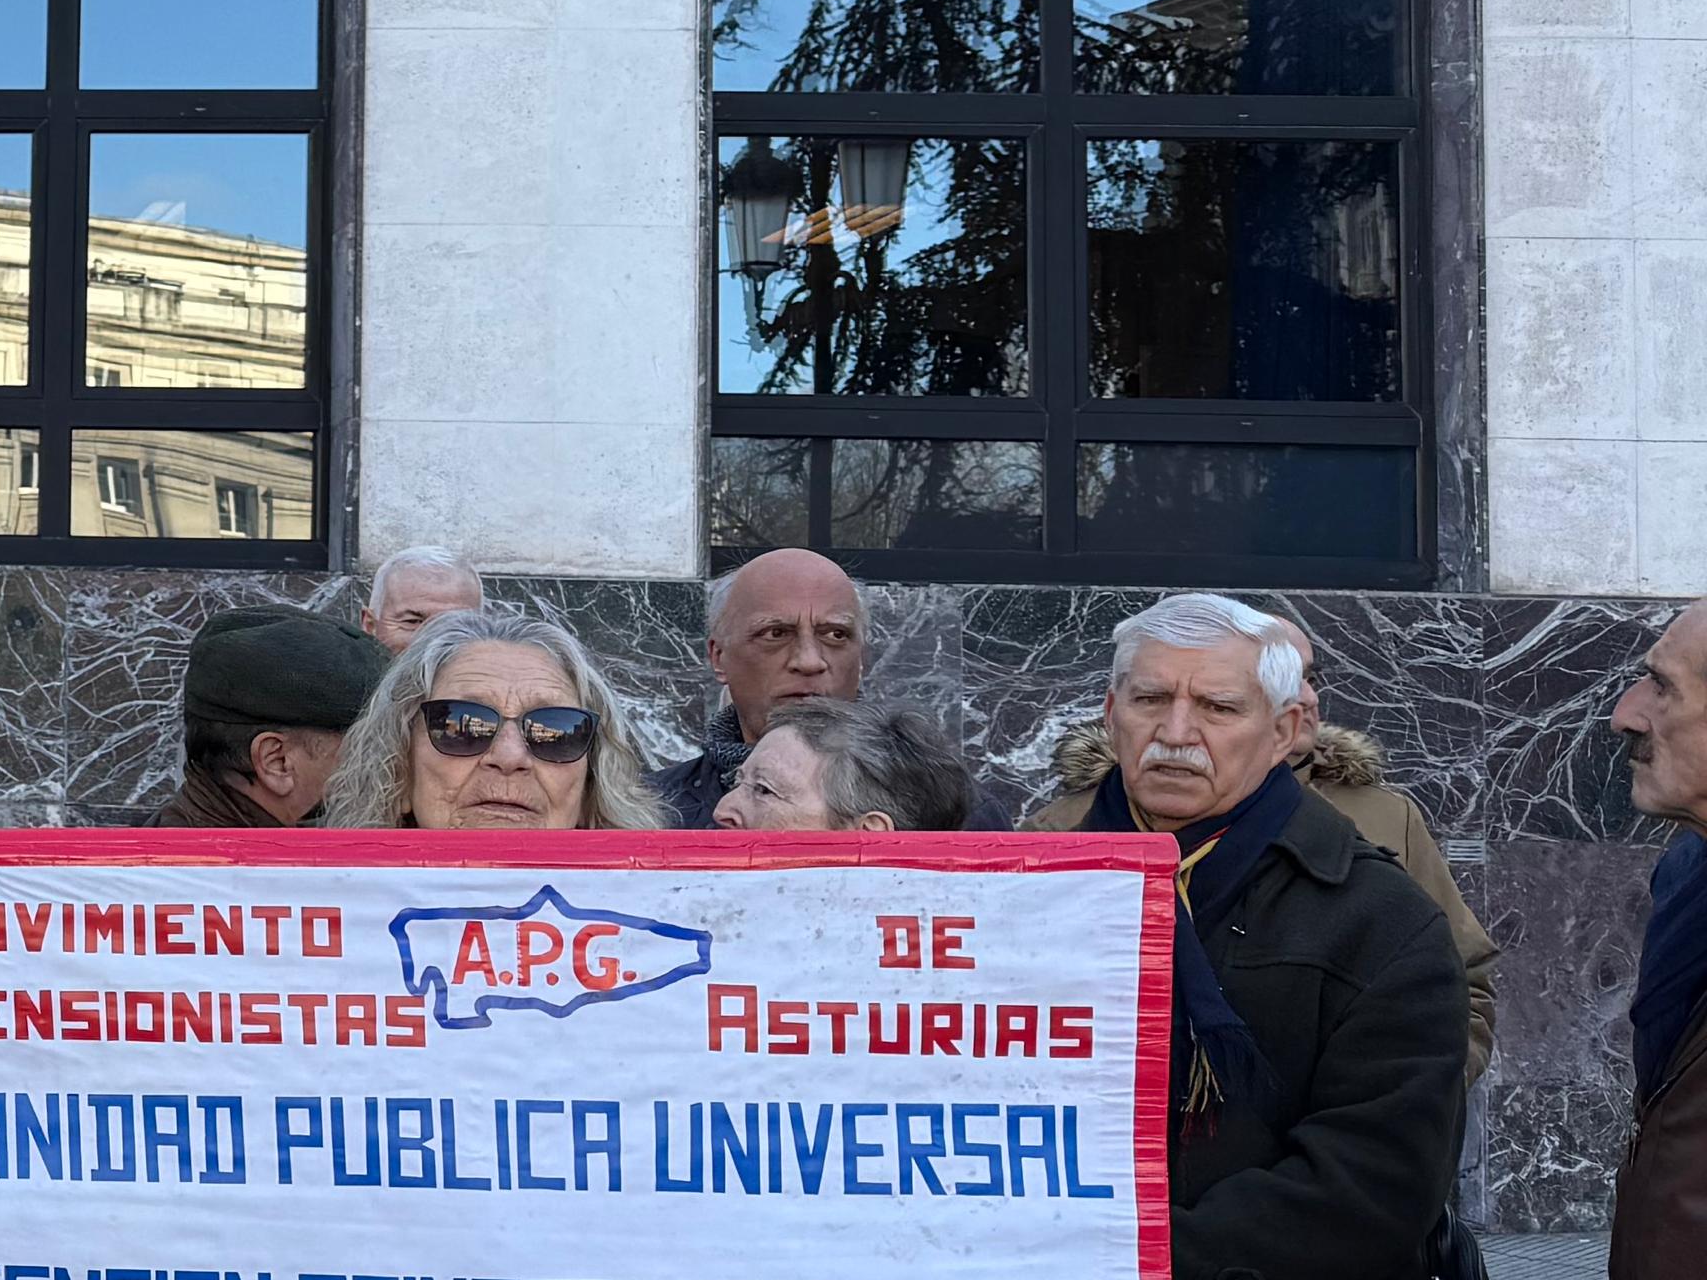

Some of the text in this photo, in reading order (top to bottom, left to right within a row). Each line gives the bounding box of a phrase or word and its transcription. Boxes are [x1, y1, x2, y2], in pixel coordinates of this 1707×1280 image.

[454, 921, 637, 992] A.P.G.
[878, 917, 975, 969] DE
[708, 985, 1093, 1059] ASTURIAS
[275, 1097, 622, 1192] PUBLICA
[654, 1101, 1115, 1199] UNIVERSAL
